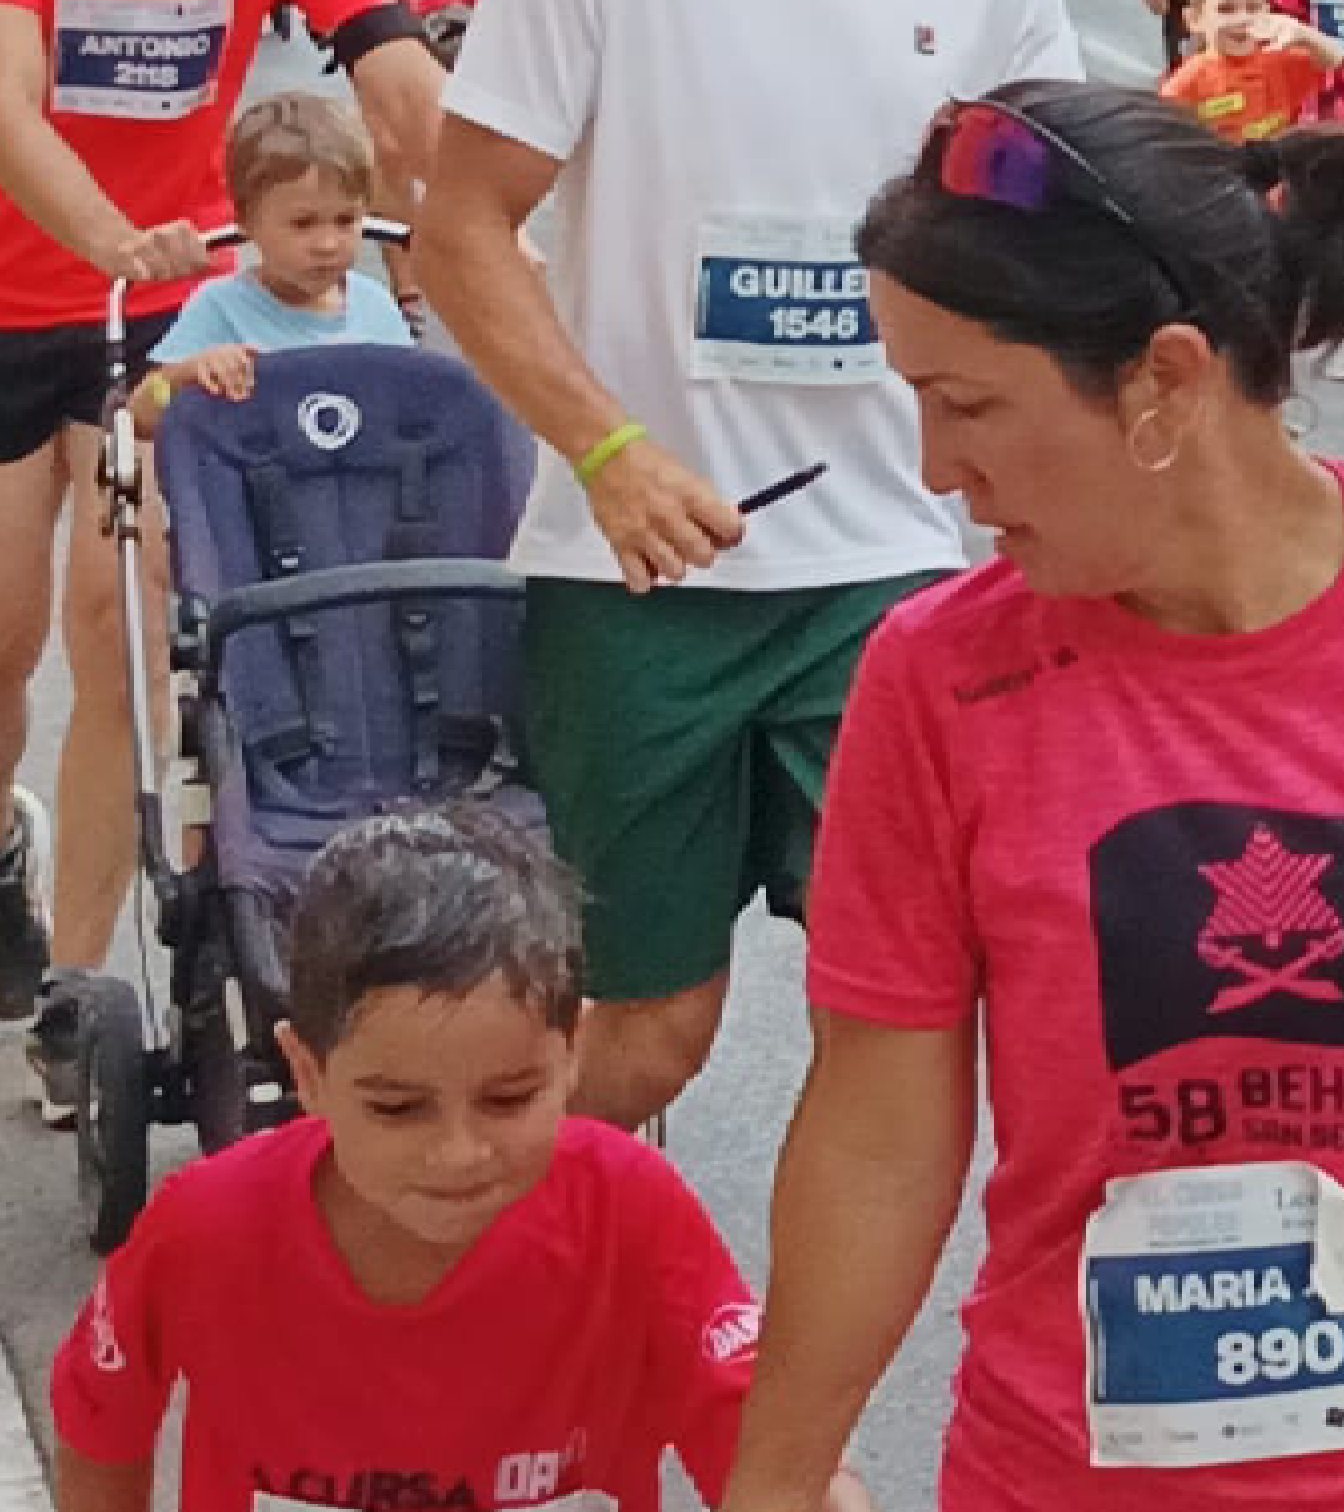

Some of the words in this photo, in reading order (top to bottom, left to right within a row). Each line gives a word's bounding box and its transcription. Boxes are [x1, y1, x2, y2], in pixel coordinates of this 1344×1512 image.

[78, 33, 211, 59] ANTONIO
[1118, 1078, 1226, 1146] 58
[1134, 1266, 1291, 1315] MARIA
